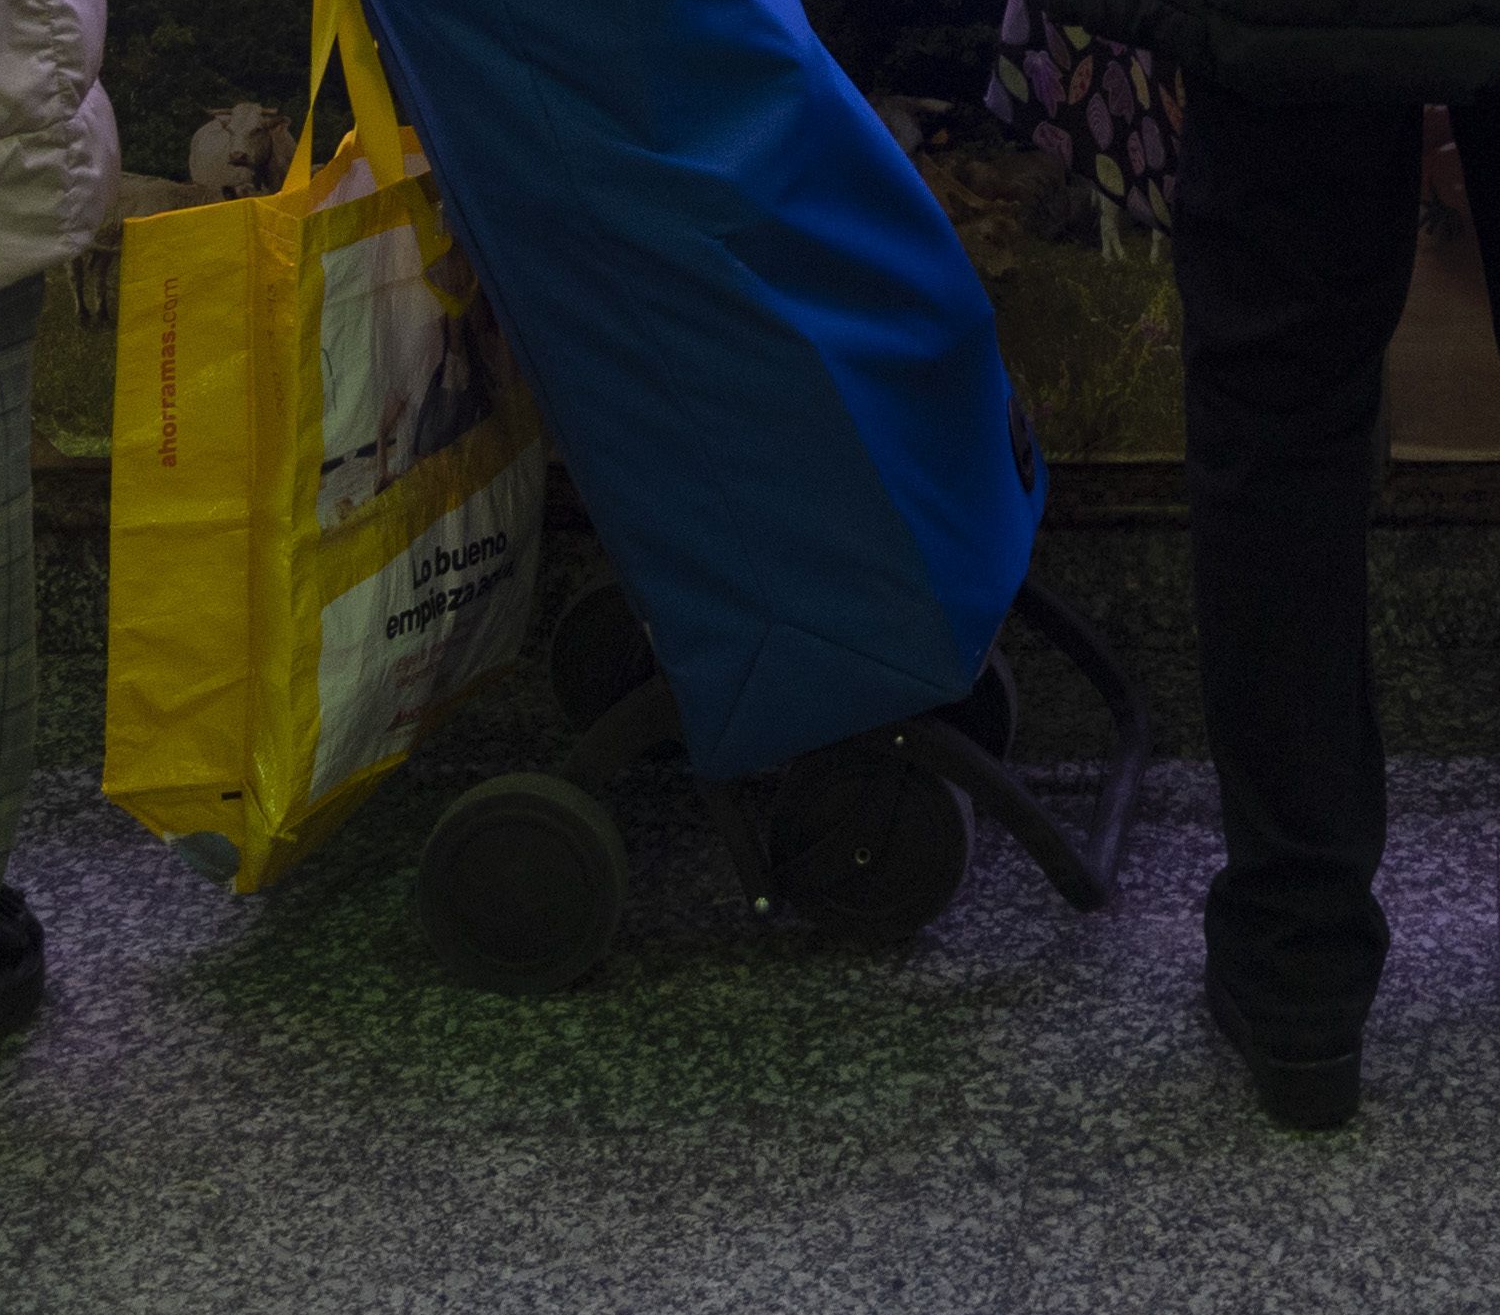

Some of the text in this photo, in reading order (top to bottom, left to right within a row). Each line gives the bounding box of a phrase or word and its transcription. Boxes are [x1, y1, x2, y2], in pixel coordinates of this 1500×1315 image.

[159, 277, 180, 469] ahorramas.com
[412, 532, 507, 589] Lo bueno
[386, 581, 475, 640] empieza
